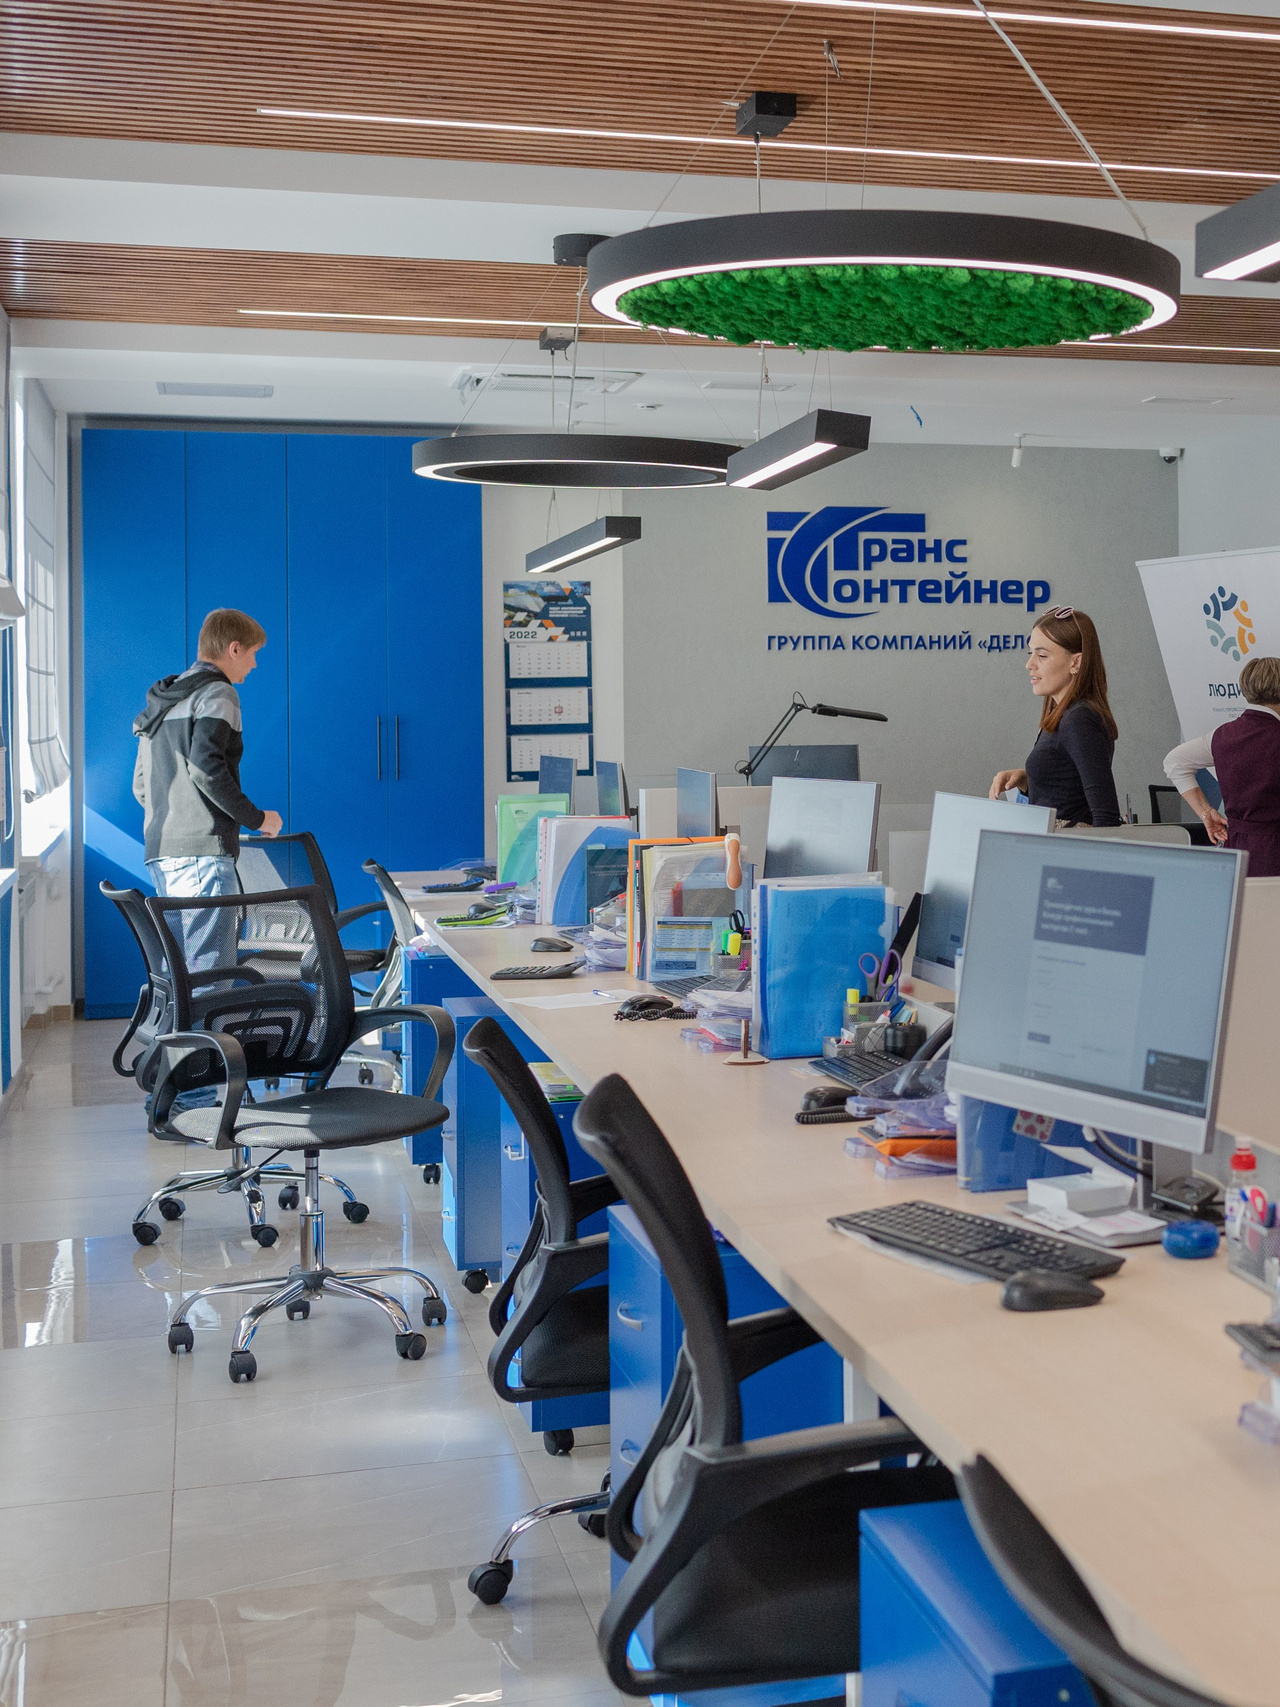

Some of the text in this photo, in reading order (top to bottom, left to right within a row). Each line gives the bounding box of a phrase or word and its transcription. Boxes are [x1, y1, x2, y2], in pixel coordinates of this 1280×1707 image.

[509, 630, 537, 639] 2022
[767, 635, 846, 651] ГРУППА
[852, 630, 972, 650] КОМПАНИЙ
